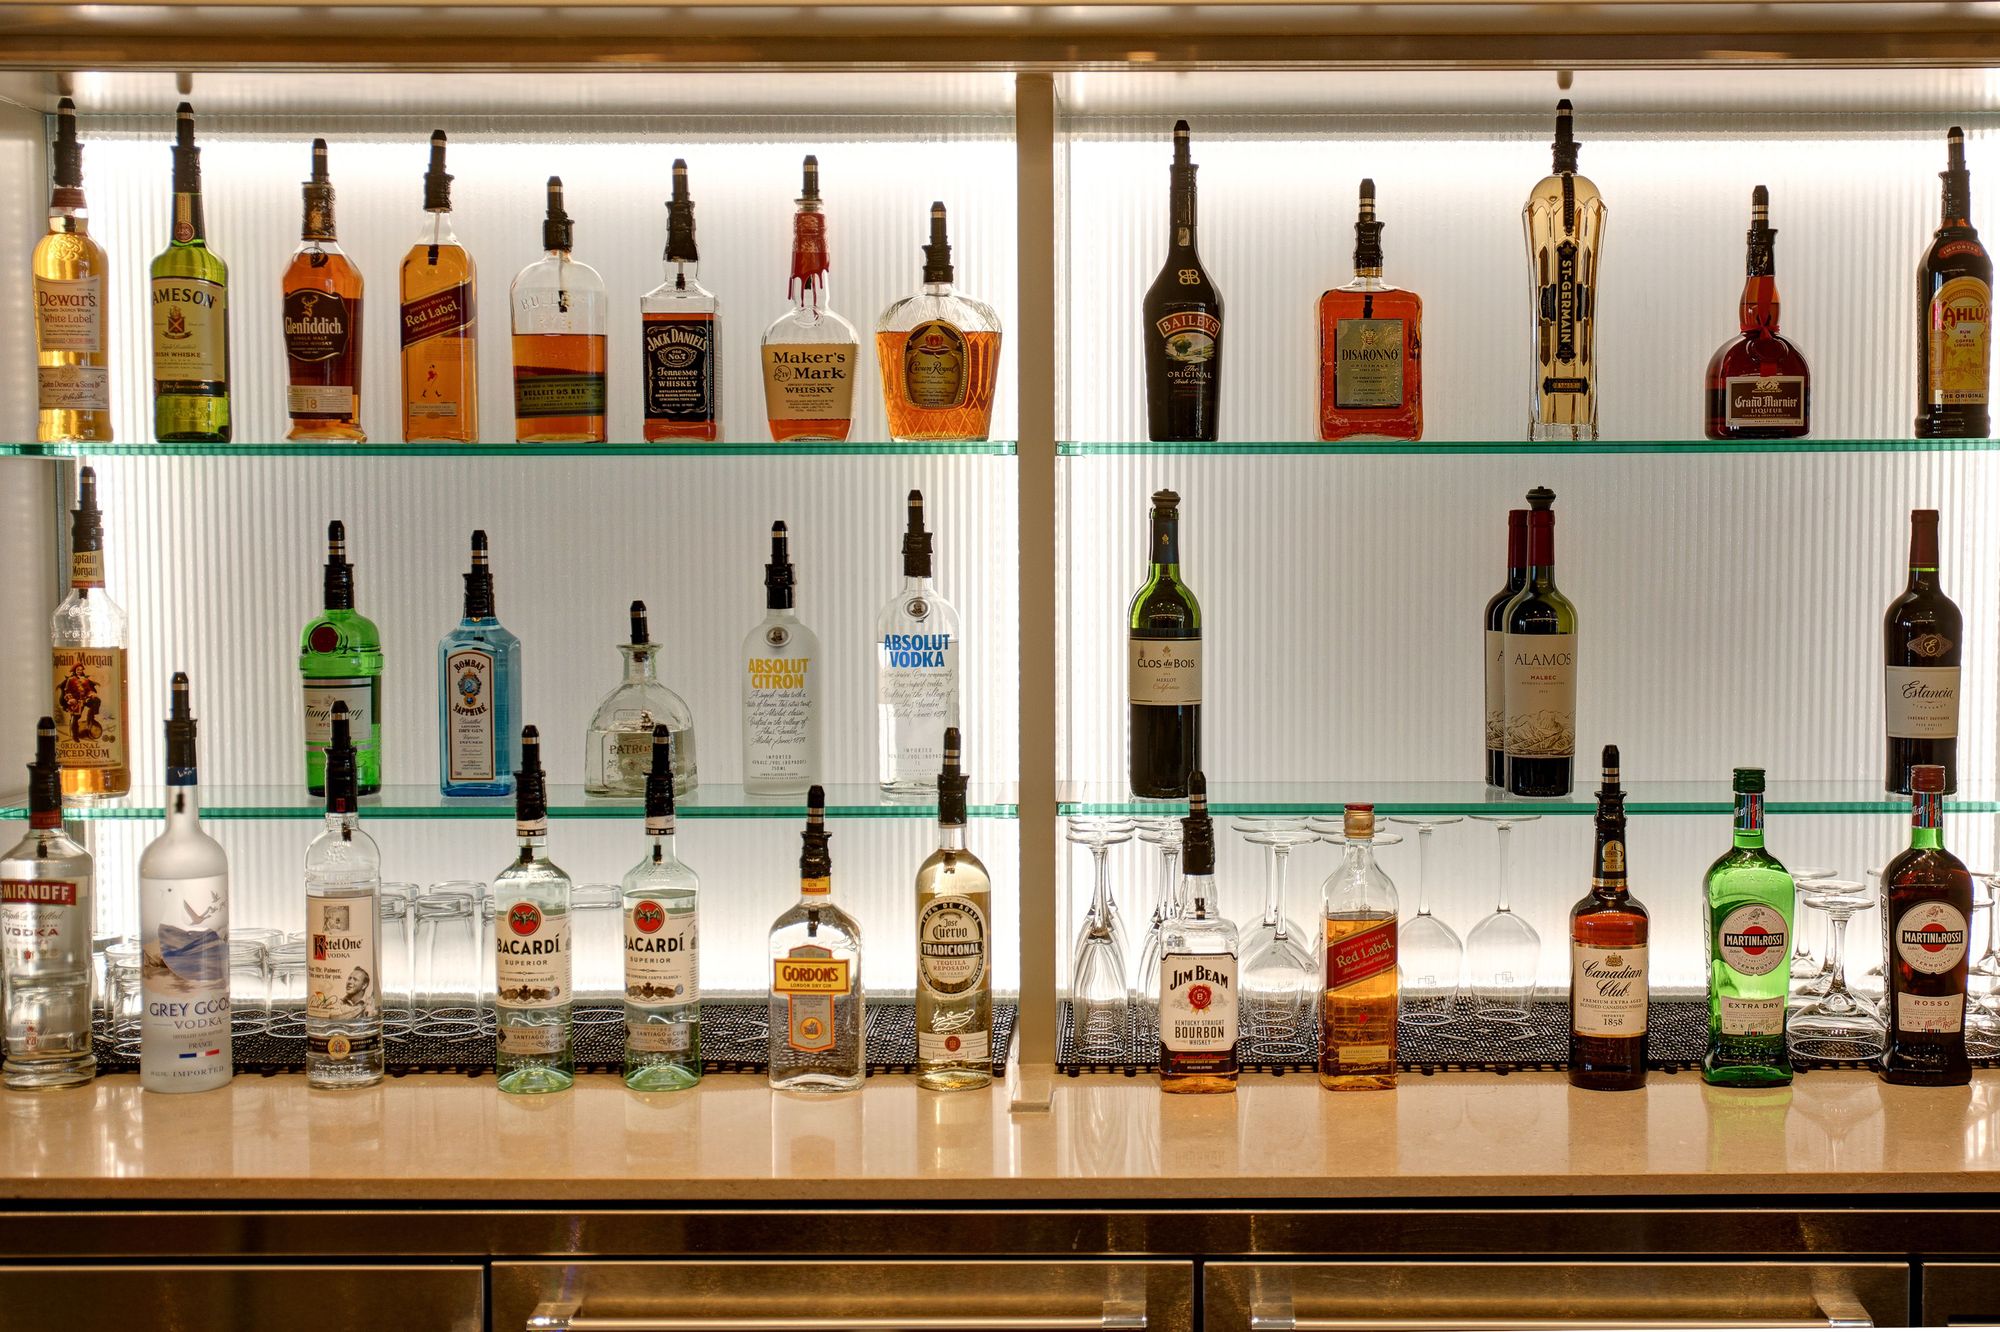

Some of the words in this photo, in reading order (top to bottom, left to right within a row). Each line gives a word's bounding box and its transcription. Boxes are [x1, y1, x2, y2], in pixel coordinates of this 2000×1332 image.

[1943, 245, 1979, 255] IMPORTED
[39, 291, 96, 307] Dewar's
[405, 310, 428, 327] Red
[428, 300, 458, 319] Label
[285, 316, 342, 334] Glenfiddich
[1162, 315, 1218, 332] BAILEYS
[646, 332, 670, 352] JACK
[670, 328, 708, 352] DANIEL'S
[773, 351, 846, 364] Maker's
[1342, 349, 1398, 361] DISARONNO
[657, 366, 698, 376] Tennessee
[793, 367, 846, 380] Mark
[909, 361, 933, 375] Crown
[1167, 371, 1212, 379] ORIGINAL
[305, 398, 318, 410] 18
[1734, 395, 1761, 408] Grand
[1763, 395, 1798, 408] Marnier
[884, 634, 950, 651] ABSOLUT
[77, 652, 113, 668] Morgan
[454, 659, 486, 673] BOMBAY
[748, 658, 810, 673] ABSOLUT
[890, 651, 945, 668] VODKA
[1137, 658, 1162, 669] CLOS
[1163, 659, 1173, 667] du
[1173, 658, 1195, 669] BOIS
[1514, 652, 1572, 666] ALAMOS
[751, 674, 805, 689] CITRON
[1901, 680, 1954, 699] Estancia
[453, 702, 489, 717] SAPPHIRE
[60, 742, 101, 750] ORIGINAL
[86, 749, 110, 759] RUM
[0, 884, 69, 901] MIRNOFF
[944, 918, 958, 928] Jose
[932, 925, 968, 941] Cuervo
[313, 935, 340, 959] Ketel
[341, 937, 362, 951] One
[922, 943, 980, 956] TRADICIONAL
[1335, 950, 1360, 969] Red
[1360, 938, 1392, 959] Label
[630, 956, 671, 964] SUPERIOR
[782, 965, 839, 982] GORDON'S
[1582, 959, 1643, 980] Canadian
[1169, 969, 1193, 991] JIM
[1195, 965, 1229, 989] BEAM
[1596, 978, 1629, 998] Club
[149, 1002, 189, 1017] GREY
[1914, 999, 1950, 1007] ROSSO
[174, 1016, 223, 1030] VODKA
[1604, 1018, 1623, 1027] 1858
[1174, 1026, 1225, 1039] BOURBON
[188, 1040, 213, 1049] FRANCE
[172, 1065, 224, 1078] IMPORTED
